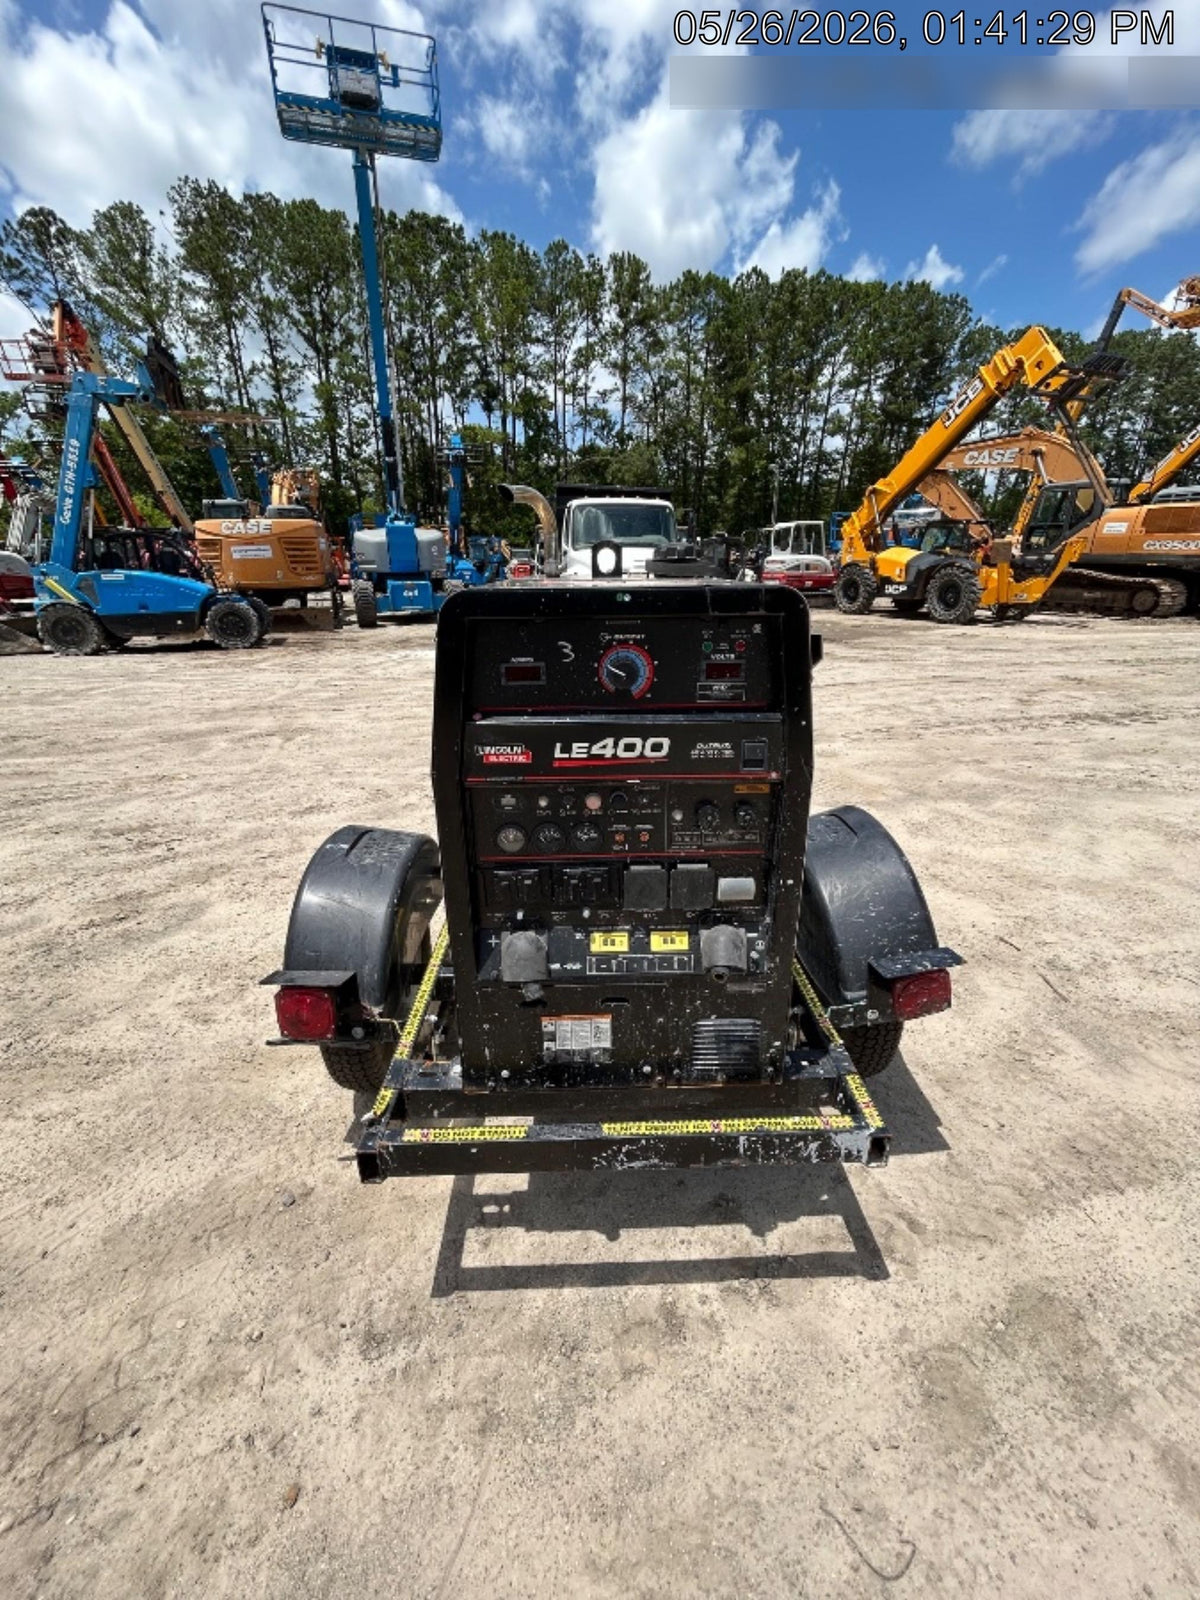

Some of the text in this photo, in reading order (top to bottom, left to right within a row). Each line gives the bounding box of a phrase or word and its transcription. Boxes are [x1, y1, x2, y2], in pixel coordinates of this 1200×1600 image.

[944, 378, 984, 428] JCB
[1180, 423, 1200, 453] JC
[963, 447, 1019, 465] CASE
[221, 520, 272, 535] CASE
[557, 641, 575, 663] 3
[478, 746, 522, 755] LINCOLN
[553, 737, 670, 758] LE400
[453, 1130, 476, 1138] NOT
[478, 1129, 516, 1137] STAND
